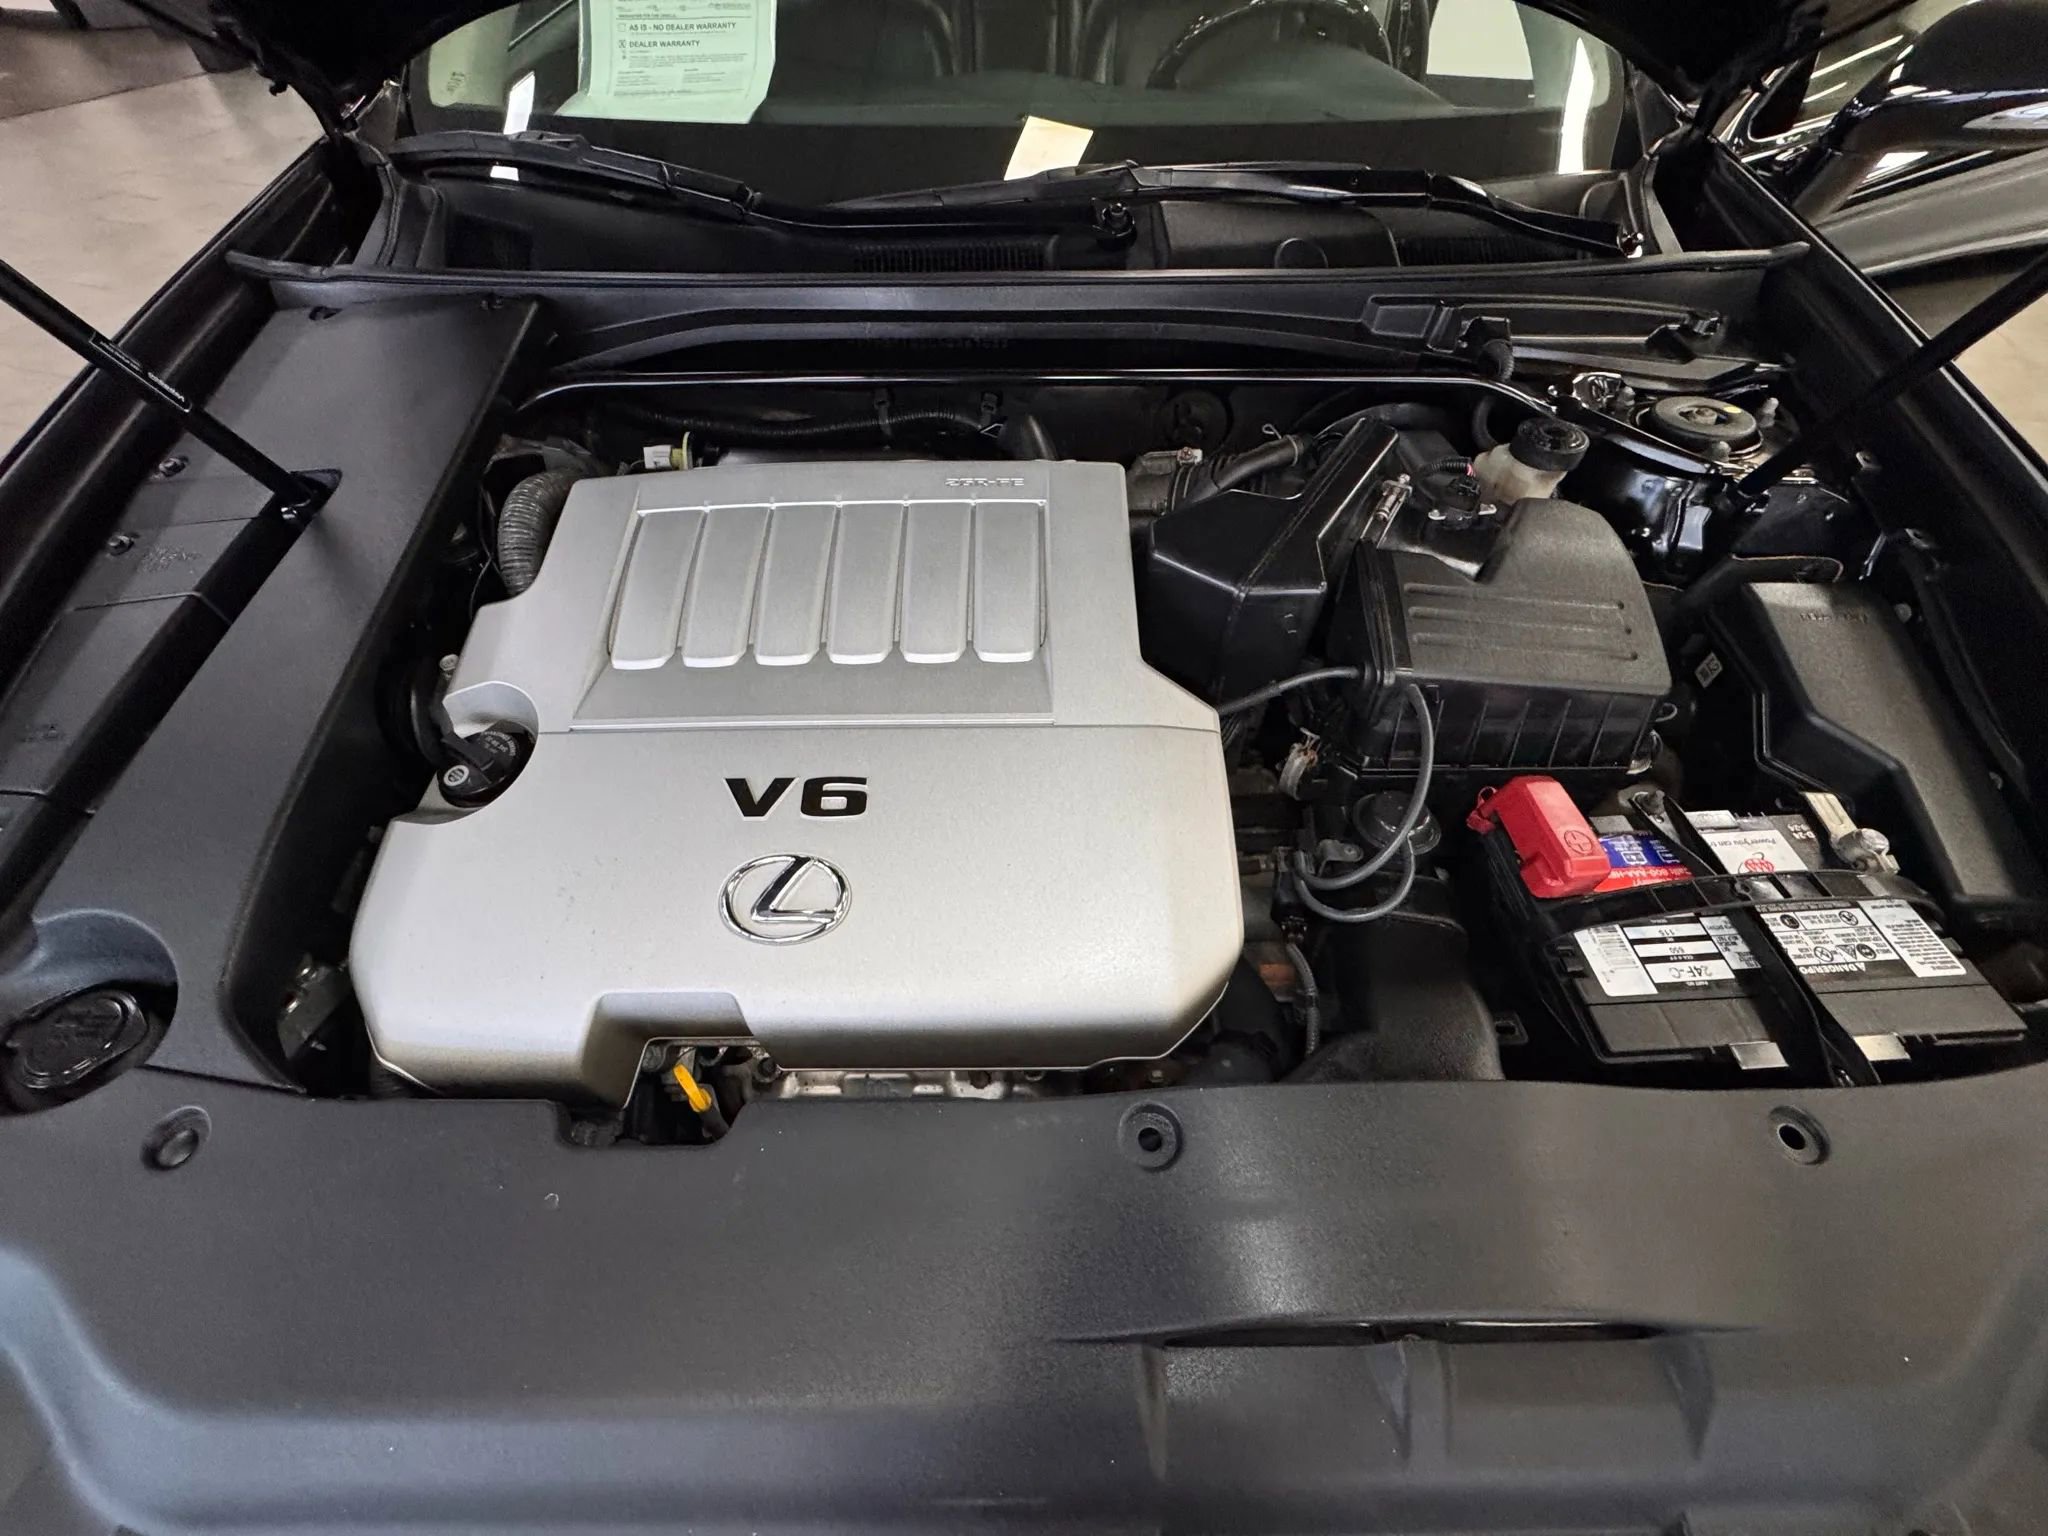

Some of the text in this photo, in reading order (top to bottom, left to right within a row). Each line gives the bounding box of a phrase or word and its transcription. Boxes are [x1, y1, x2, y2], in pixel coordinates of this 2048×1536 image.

[696, 22, 736, 30] WARRANTY
[629, 40, 658, 48] DEALER
[660, 40, 700, 48] WARRANTY
[724, 776, 868, 820] V6
[1668, 965, 1713, 979] 24F-C
[1798, 962, 1858, 975] DANGER/PO
